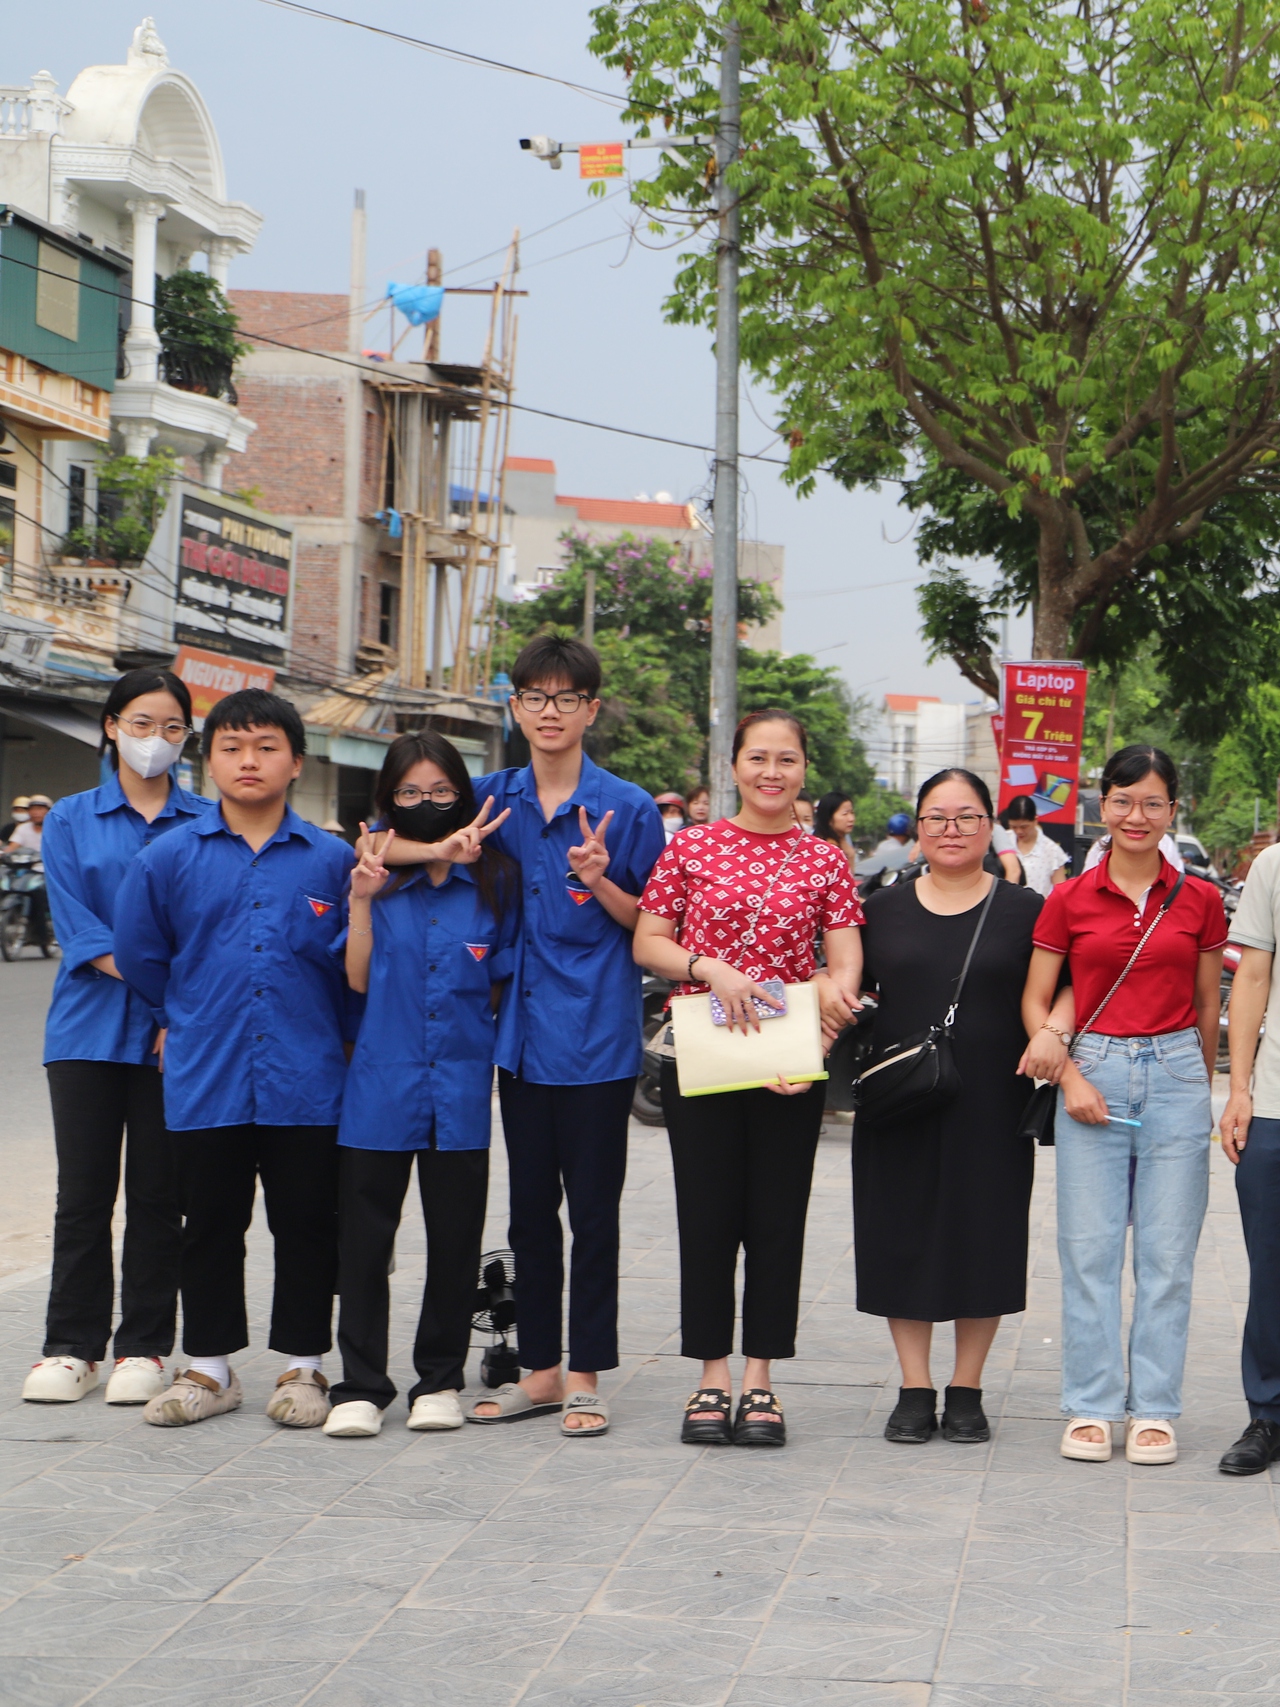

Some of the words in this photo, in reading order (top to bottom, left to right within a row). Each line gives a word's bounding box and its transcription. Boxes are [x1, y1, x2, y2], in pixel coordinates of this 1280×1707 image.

[1016, 670, 1075, 694] Laptop
[1016, 694, 1035, 705] Giá
[1022, 711, 1044, 740] 7
[1043, 730, 1073, 743] Triệu
[574, 1396, 600, 1405] NIKE
